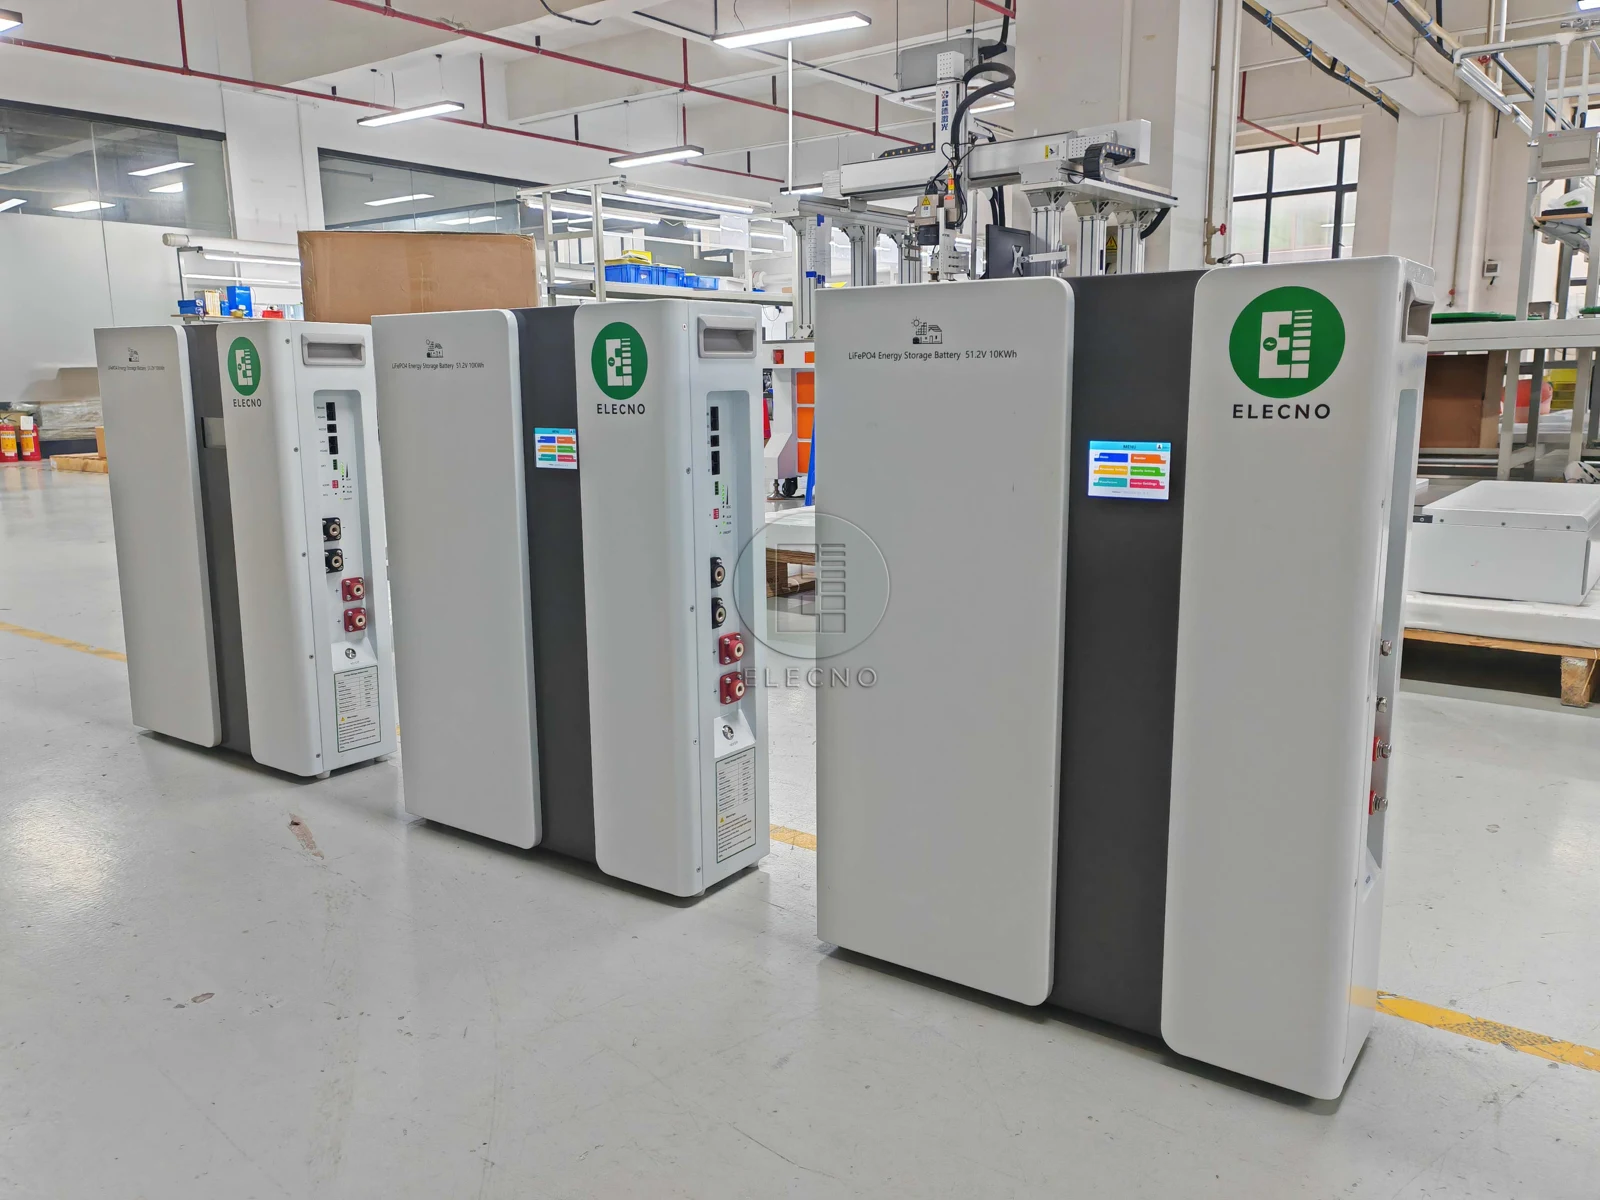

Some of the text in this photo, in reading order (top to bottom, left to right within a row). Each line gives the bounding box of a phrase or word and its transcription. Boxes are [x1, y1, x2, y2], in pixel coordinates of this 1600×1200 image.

[848, 350, 1018, 361] LiFePO4 Energy Storage Battery 51.2V 10KWh
[408, 362, 422, 370] Energy
[422, 362, 438, 370] Storage
[439, 362, 454, 370] Battery
[232, 399, 262, 408] ELECNO
[597, 403, 646, 415] ELECNO
[1232, 403, 1331, 420] ELECNO
